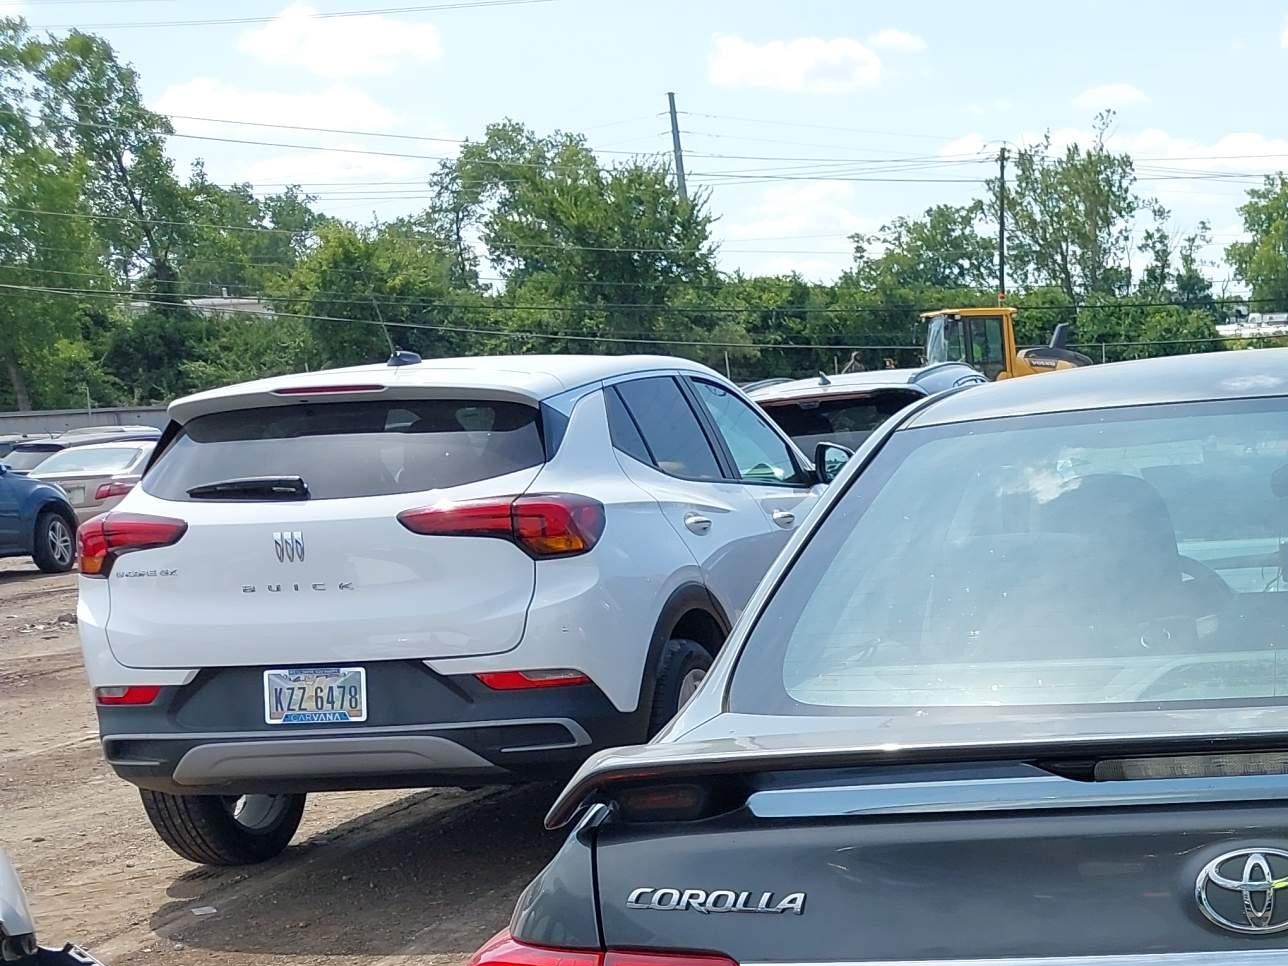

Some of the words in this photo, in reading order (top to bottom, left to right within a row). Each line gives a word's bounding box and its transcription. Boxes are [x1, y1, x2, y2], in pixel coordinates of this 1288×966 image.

[241, 582, 355, 593] BUICK
[274, 686, 307, 712] KZZ
[314, 685, 359, 711] 6478
[290, 713, 341, 721] CARVANA
[626, 887, 807, 915] COROLLA
